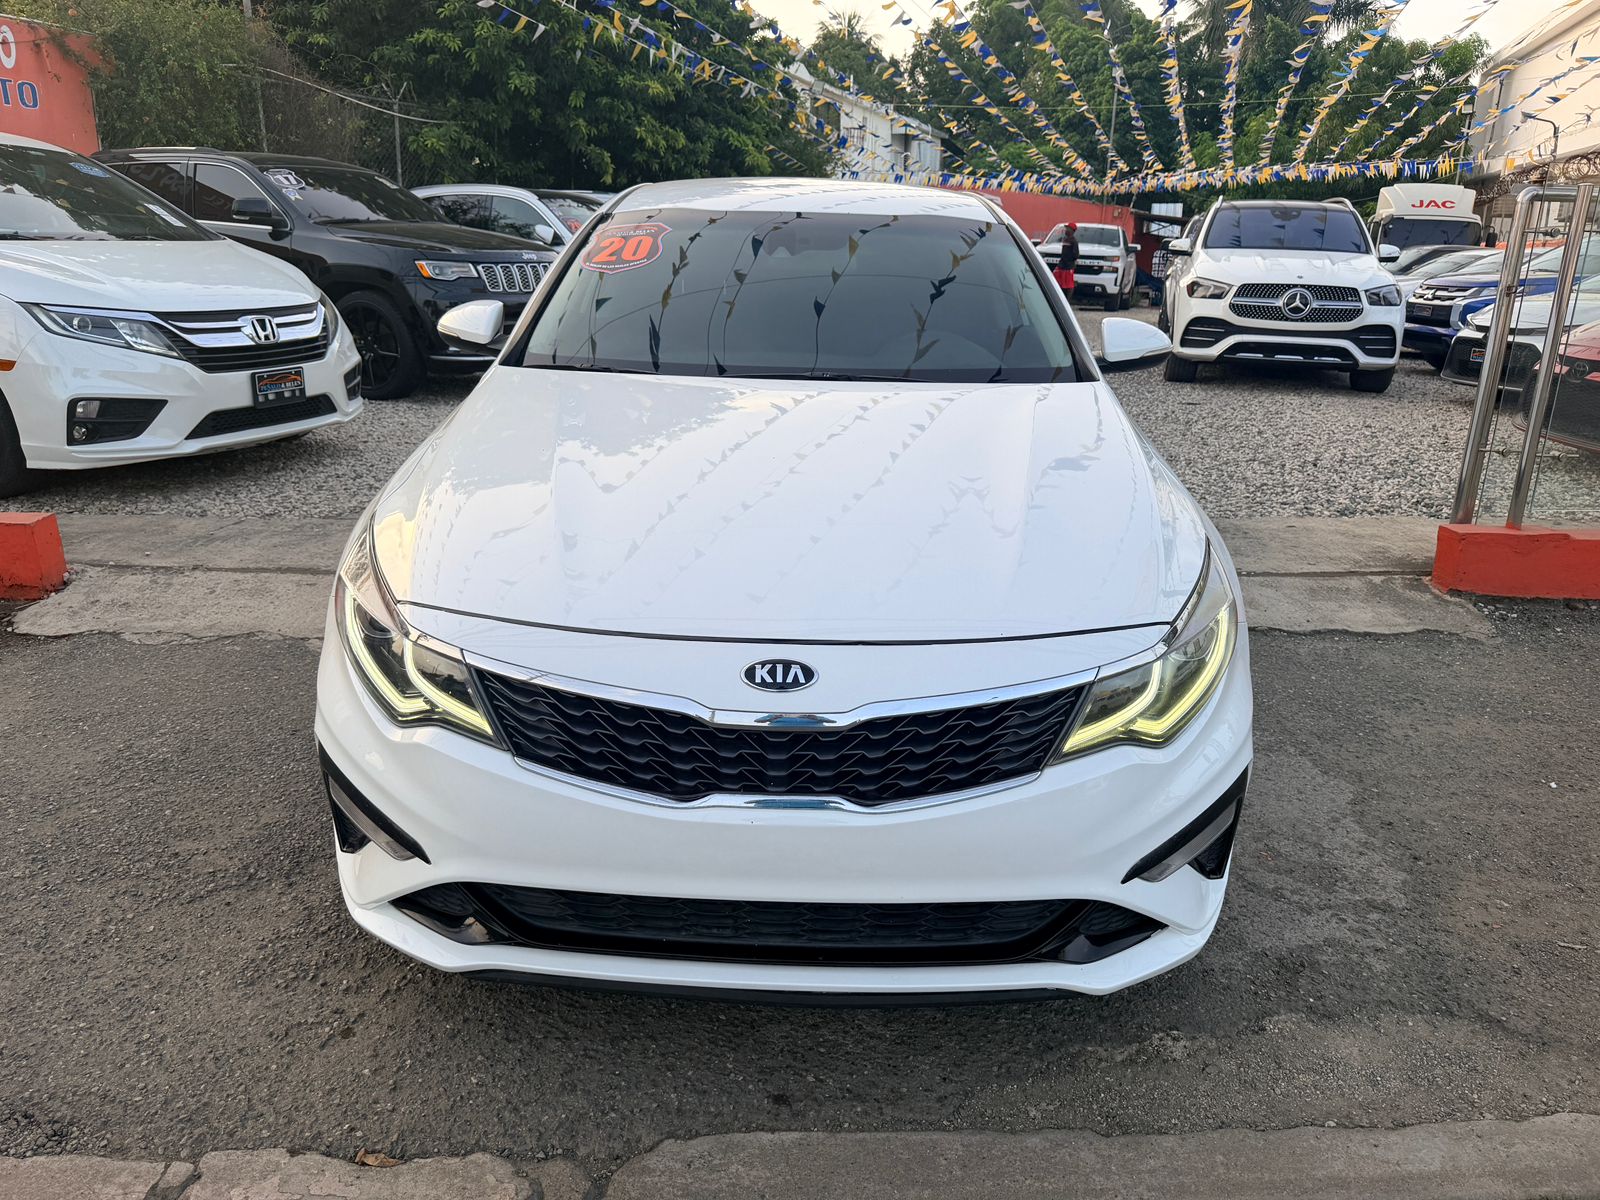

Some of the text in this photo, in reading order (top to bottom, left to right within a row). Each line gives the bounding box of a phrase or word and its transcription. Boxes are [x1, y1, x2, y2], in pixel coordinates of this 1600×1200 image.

[273, 174, 298, 185] 17
[1411, 199, 1456, 209] JAC
[592, 236, 653, 262] 20
[521, 252, 537, 261] Jeep
[754, 663, 806, 683] KIA
